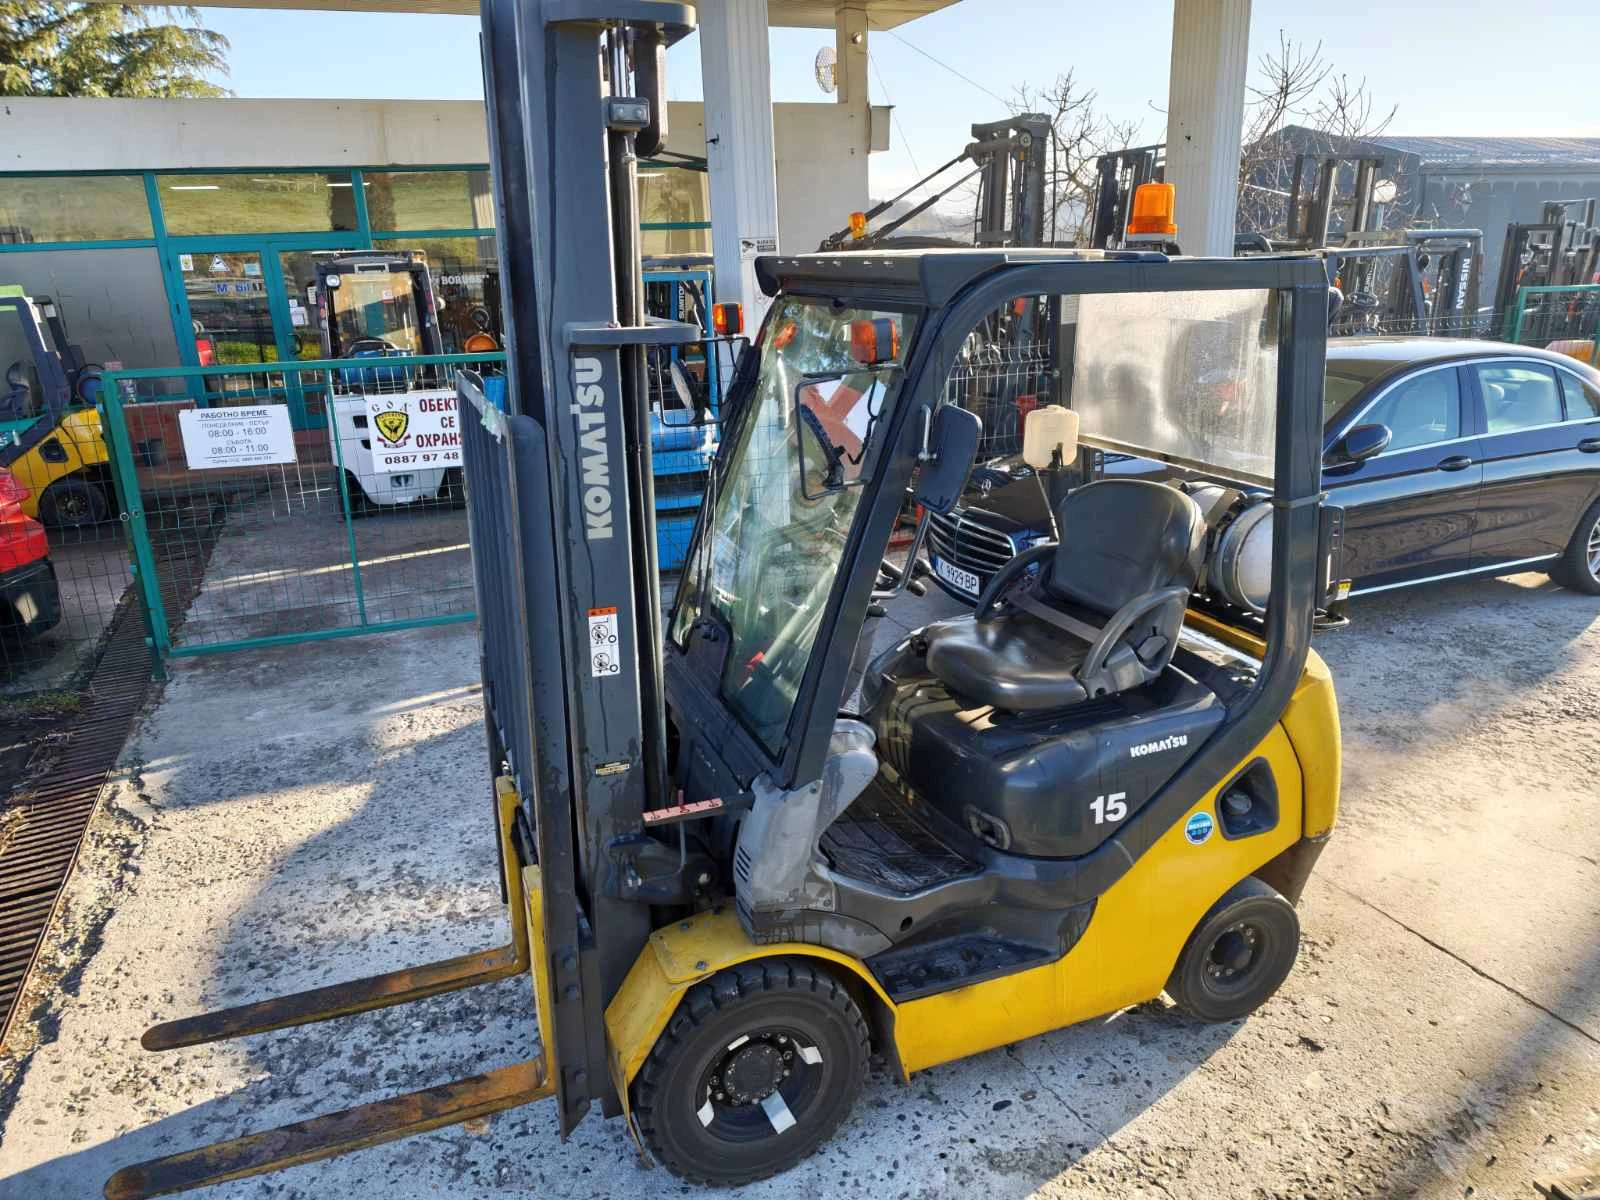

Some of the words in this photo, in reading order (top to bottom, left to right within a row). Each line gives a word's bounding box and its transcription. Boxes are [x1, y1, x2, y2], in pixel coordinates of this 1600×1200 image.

[1456, 258, 1470, 309] NISSAN
[419, 398, 458, 413] ОБЕКТ
[200, 411, 239, 419] РАБОТНО
[240, 409, 268, 417] ВРЕМЕ
[440, 416, 455, 429] СЕ
[208, 429, 234, 438] 08:00
[416, 432, 462, 448] ОХРАН
[570, 357, 613, 540] KOMATSU
[385, 454, 417, 465] 0887
[423, 453, 438, 462] 97
[443, 452, 459, 461] 48
[1129, 735, 1188, 758] KOMATSU
[1090, 792, 1127, 824] 15
